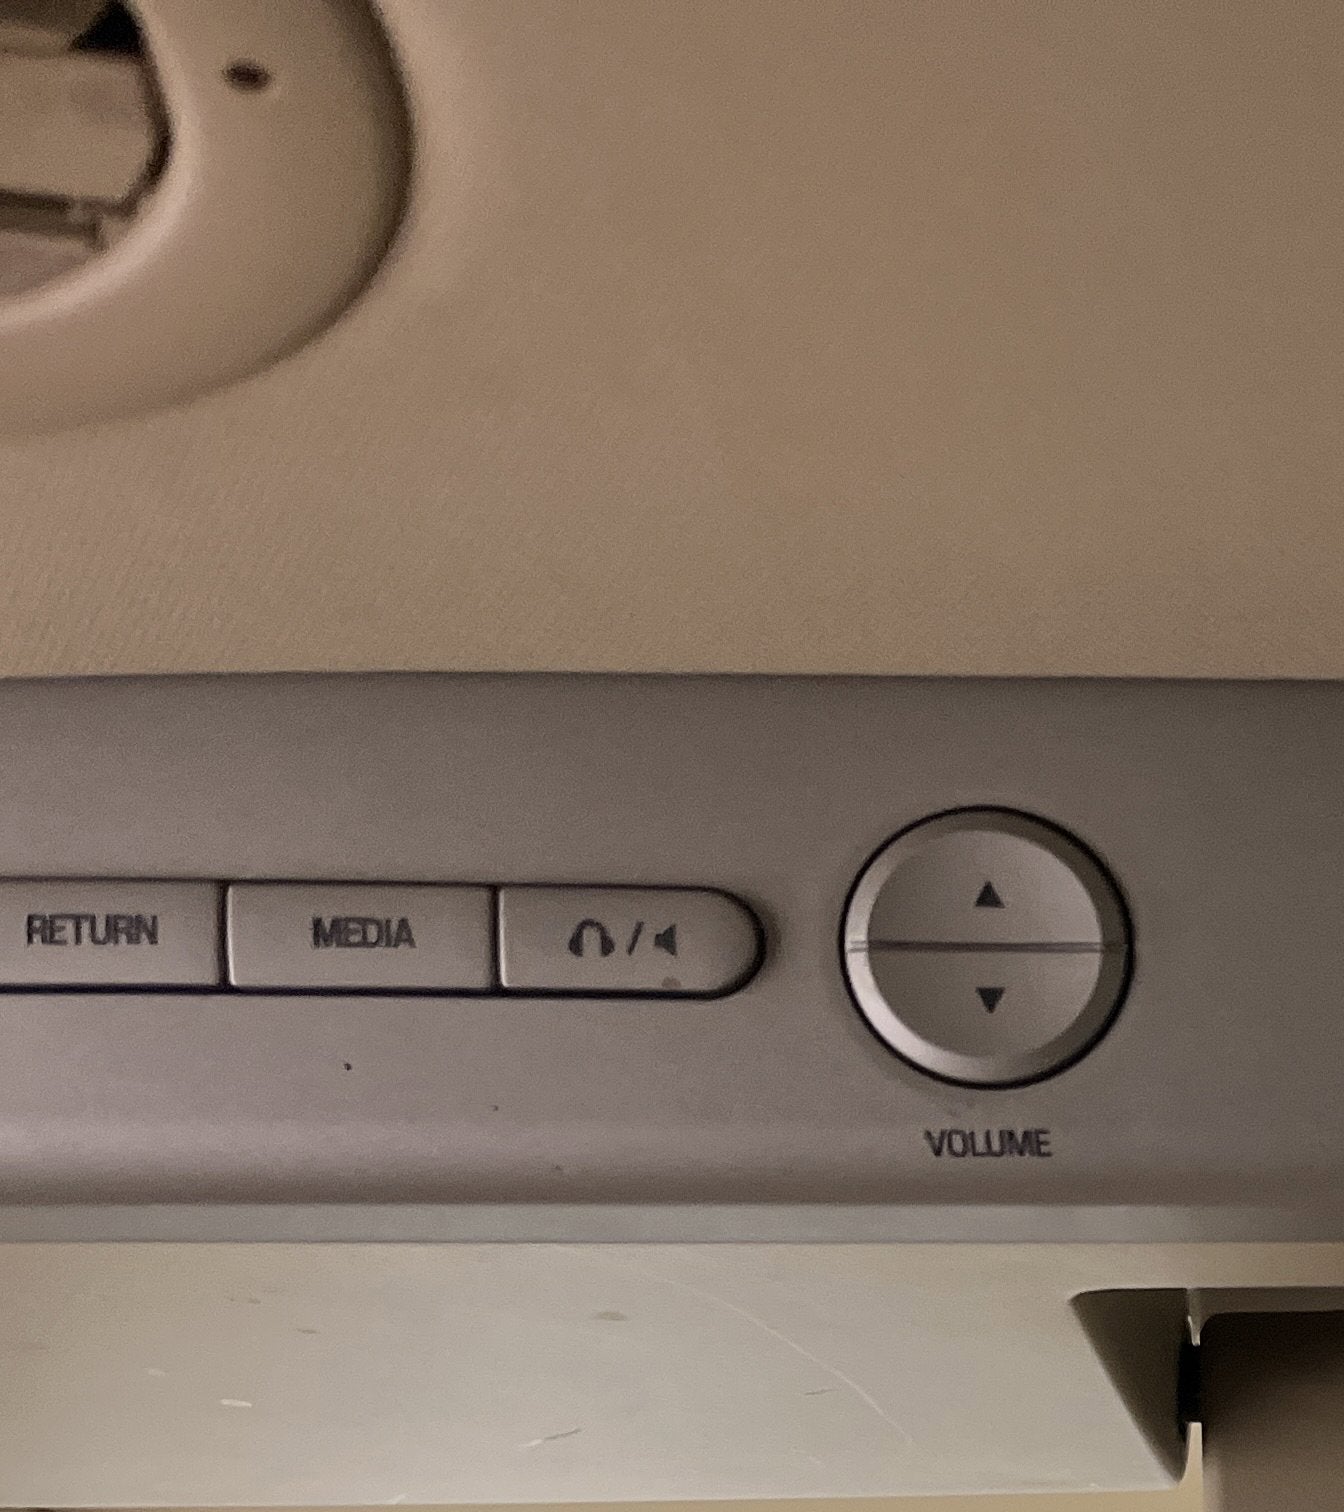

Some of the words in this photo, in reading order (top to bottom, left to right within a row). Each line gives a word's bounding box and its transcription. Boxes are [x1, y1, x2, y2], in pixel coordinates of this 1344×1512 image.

[27, 913, 159, 946] RETURN
[311, 916, 417, 949] MEDIA
[924, 1129, 1052, 1158] VOLUME
